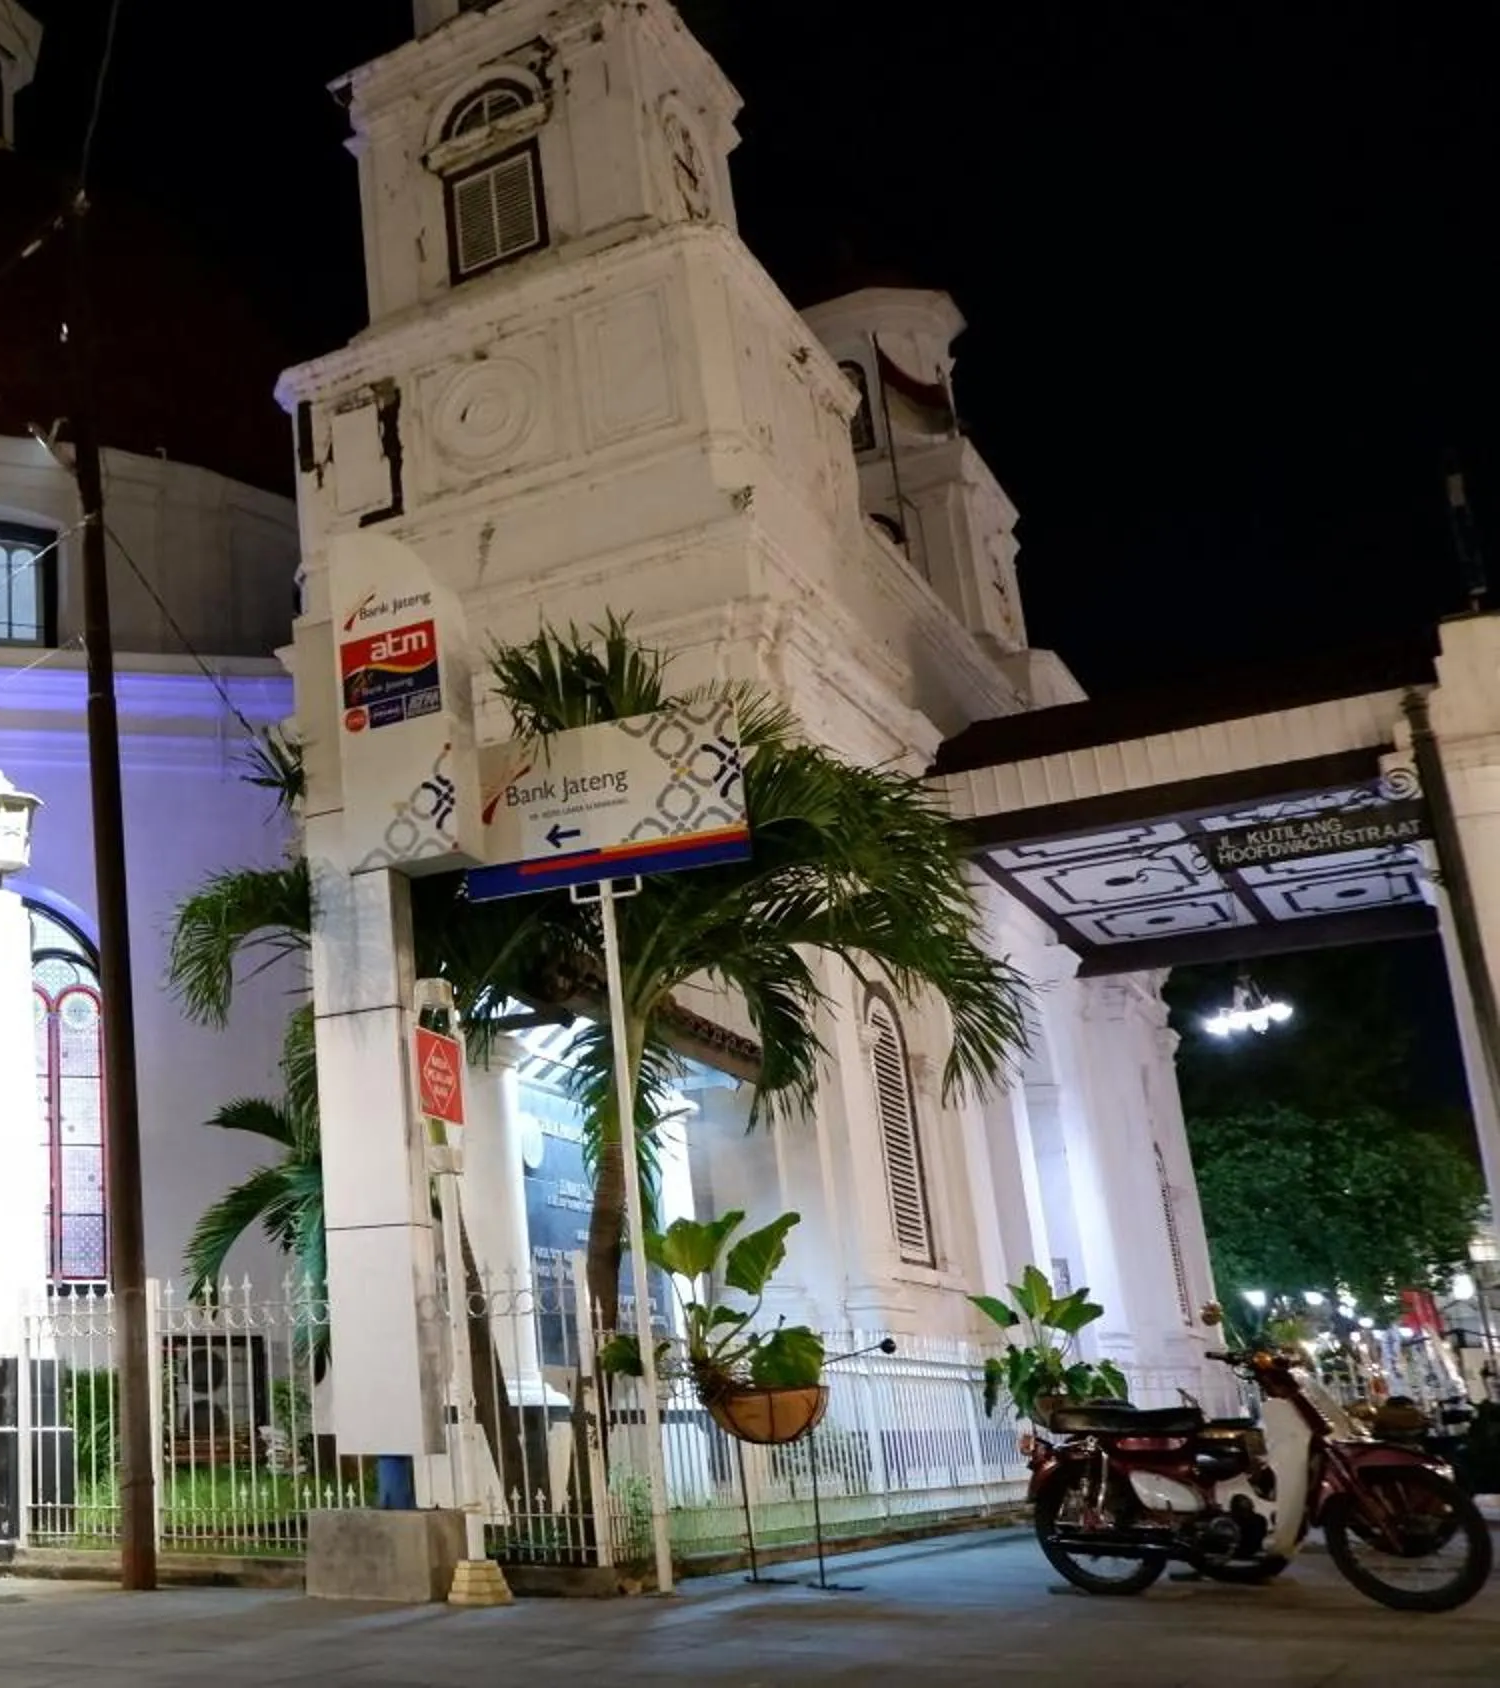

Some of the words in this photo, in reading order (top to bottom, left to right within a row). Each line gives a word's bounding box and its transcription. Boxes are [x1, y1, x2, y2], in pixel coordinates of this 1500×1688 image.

[359, 600, 389, 620] Bank
[392, 592, 431, 614] Jateng
[371, 631, 427, 661] atm
[505, 780, 556, 807] Bank
[561, 769, 629, 802] Jateng
[1217, 818, 1421, 866] HOOFDWACHTSTRAAT
[1246, 817, 1342, 845] KUTILANG
